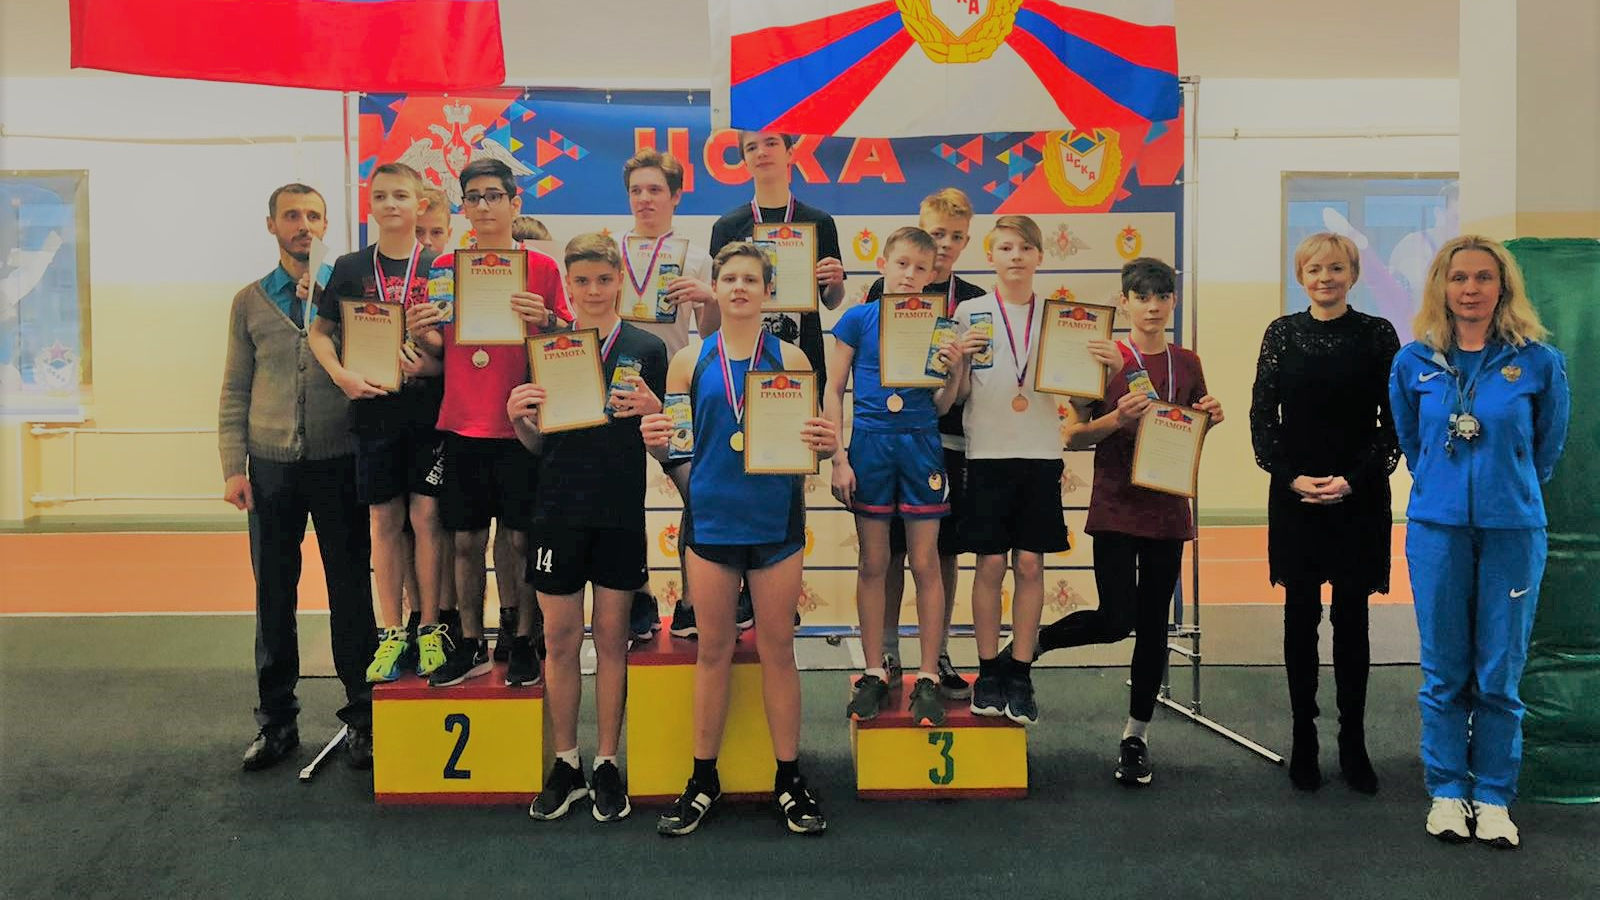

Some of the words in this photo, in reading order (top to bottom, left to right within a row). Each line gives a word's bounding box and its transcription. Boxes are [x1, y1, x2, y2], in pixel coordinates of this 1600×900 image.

[1065, 153, 1096, 181] ЦСКА
[471, 268, 512, 276] ГРАМОТА
[354, 315, 392, 325] ГРАМОТА
[894, 311, 934, 319] ГРАМОТА
[1057, 319, 1098, 331] ГРАМОТА
[543, 348, 586, 360] ГРАМОТА
[760, 391, 803, 399] ГРАМОТА
[1153, 418, 1192, 433] ГРАМОТА
[535, 546, 553, 573] 14
[443, 713, 471, 779] 2
[928, 731, 954, 785] 3
